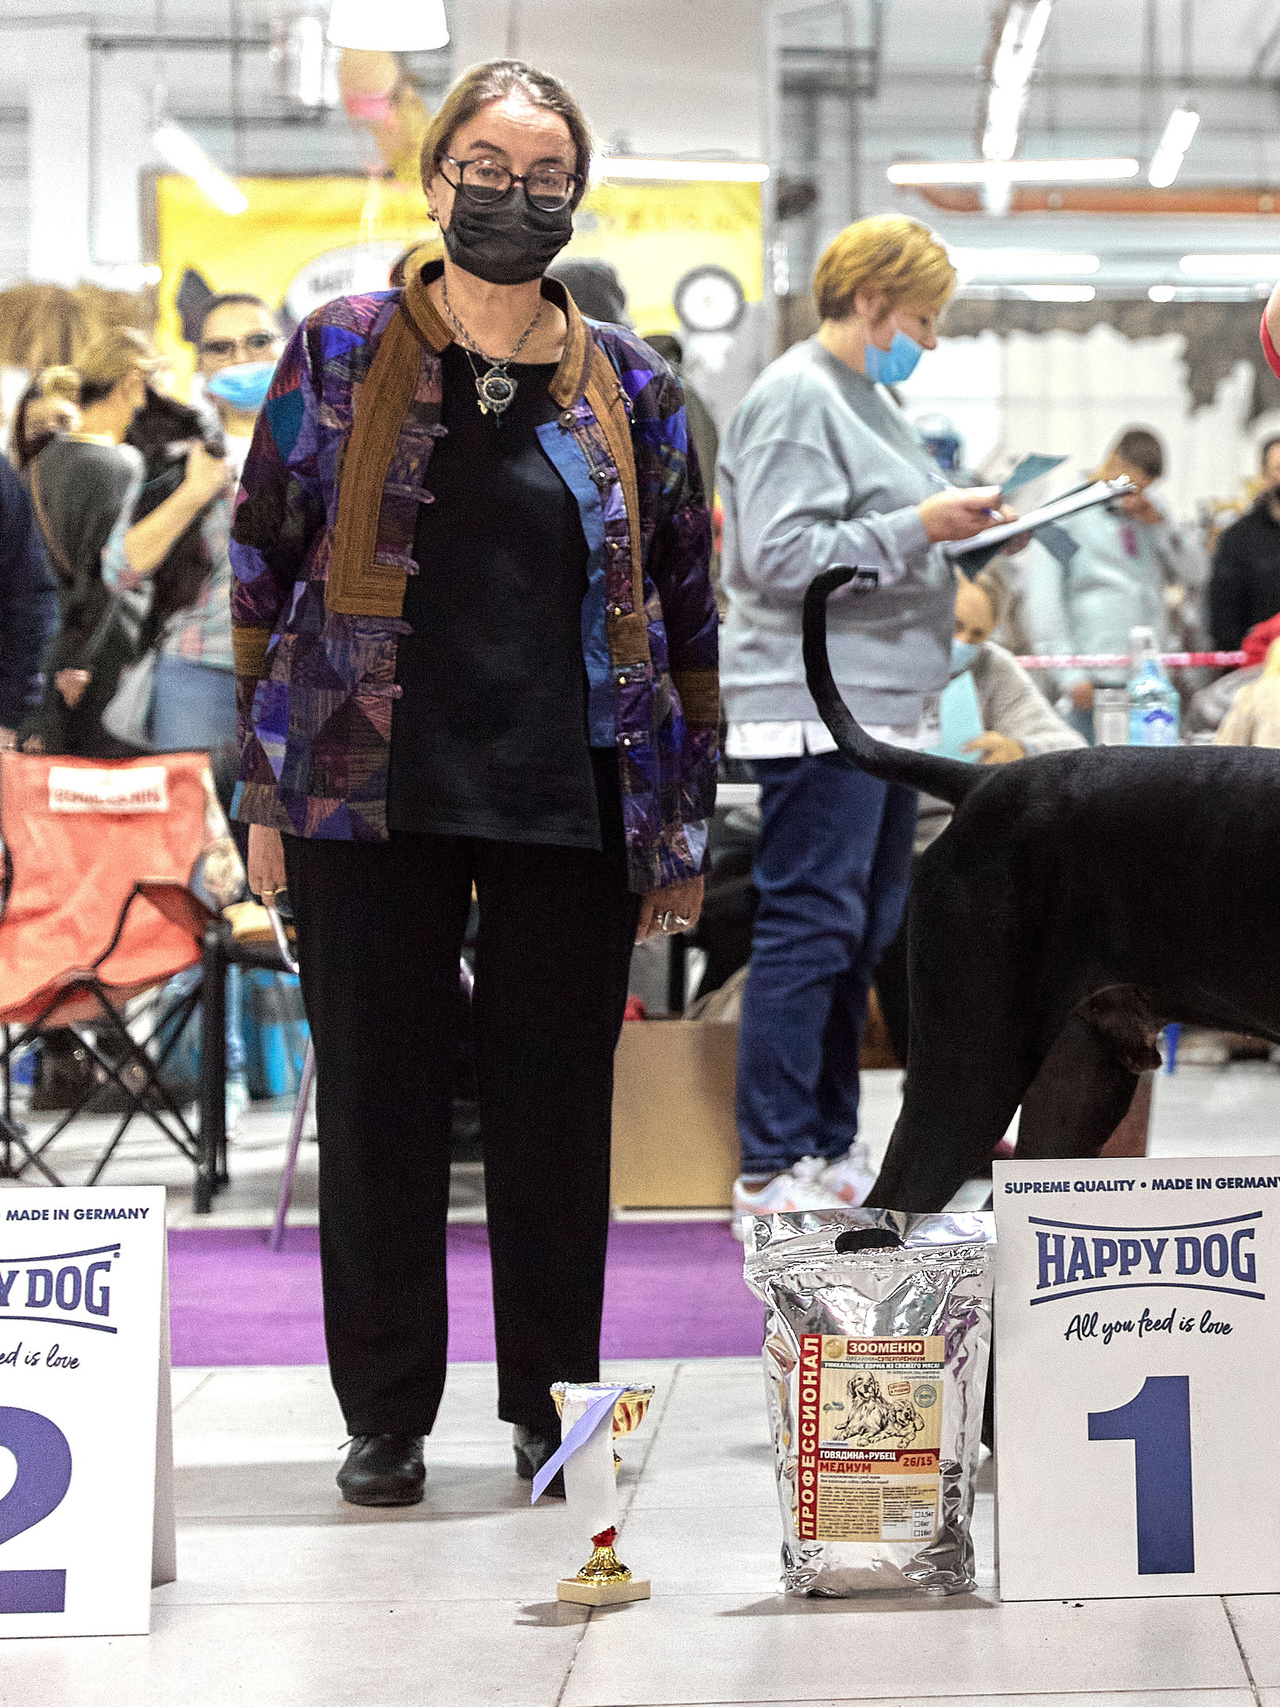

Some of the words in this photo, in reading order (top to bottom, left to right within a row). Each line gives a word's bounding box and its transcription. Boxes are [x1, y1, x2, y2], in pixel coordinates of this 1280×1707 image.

[1005, 1181, 1070, 1194] SUPREME
[1073, 1179, 1135, 1193] QUALITY
[1151, 1178, 1193, 1191] MADE
[1196, 1177, 1212, 1190] IN
[6, 1209, 49, 1221] MADE
[53, 1209, 69, 1220] IN
[74, 1208, 149, 1220] GERMANY
[1036, 1231, 1169, 1290] HAPPY
[1175, 1227, 1257, 1284] DOG
[25, 1260, 112, 1317] DOG
[1064, 1312, 1098, 1341] All
[1102, 1320, 1135, 1345] you
[1138, 1308, 1177, 1338] feed
[1178, 1317, 1195, 1333] is
[1199, 1309, 1233, 1335] love
[24, 1351, 41, 1366] is
[46, 1343, 80, 1369] love
[849, 1342, 922, 1353] ЗООМЕНЮ
[801, 1337, 819, 1537] ПРОФЕССИОНАЛ
[820, 1450, 896, 1461] ГОВЯДИНА+РУБЕЦ
[903, 1456, 933, 1467] 26/15
[820, 1462, 871, 1473] МЕДИУМ
[1088, 1376, 1195, 1575] 1
